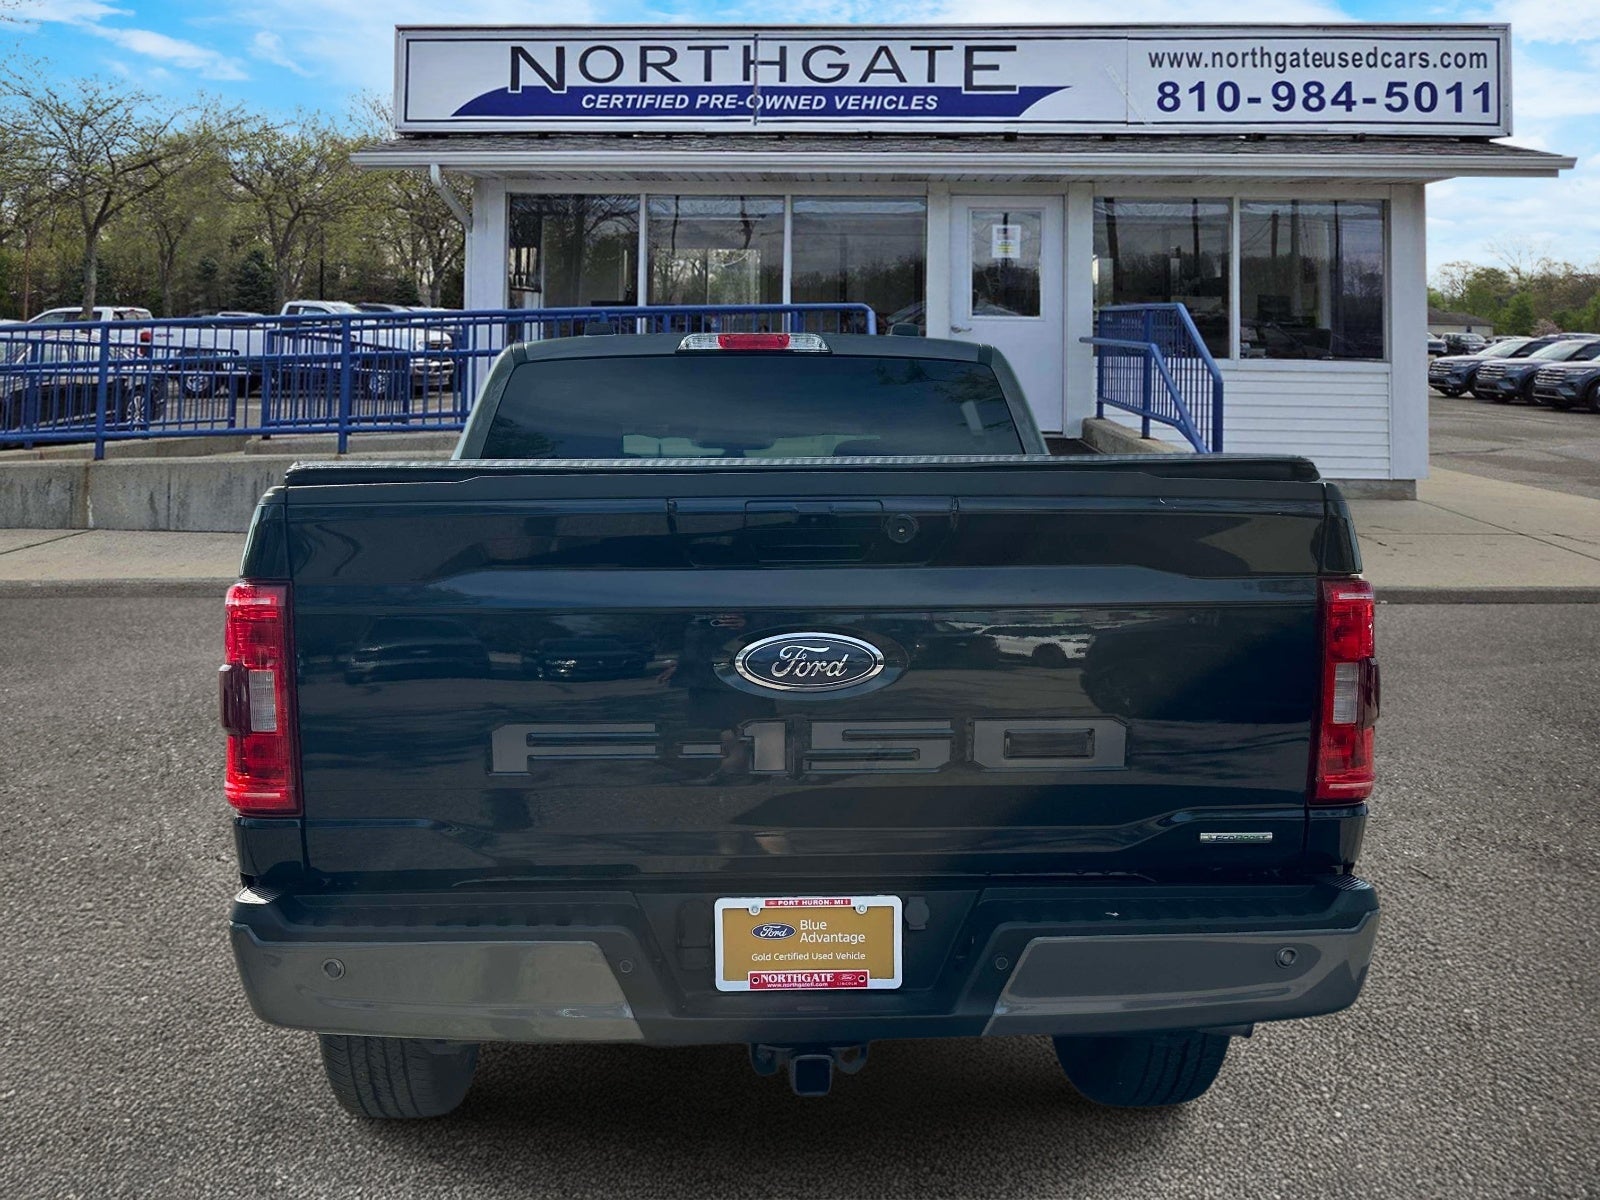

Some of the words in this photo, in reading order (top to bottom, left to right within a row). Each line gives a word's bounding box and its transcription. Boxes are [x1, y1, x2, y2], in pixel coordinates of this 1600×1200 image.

[1149, 46, 1488, 73] www.northgateusedcars.com
[510, 45, 1018, 92] NORTHGATE
[581, 94, 690, 110] CERTIFIED
[695, 94, 827, 111] PRE-OWNED
[834, 95, 939, 111] VEHICLES
[1156, 80, 1490, 113] 810-984-5011
[770, 645, 848, 678] Ford
[489, 719, 1128, 774] F-150
[759, 925, 788, 938] Ford
[800, 920, 827, 931] Blue
[800, 932, 866, 944] Advantage
[751, 953, 772, 962] Gold
[773, 951, 809, 961] Certified
[811, 951, 833, 960] Used
[835, 951, 866, 960] Vehicle
[760, 973, 834, 983] NORTHGATE
